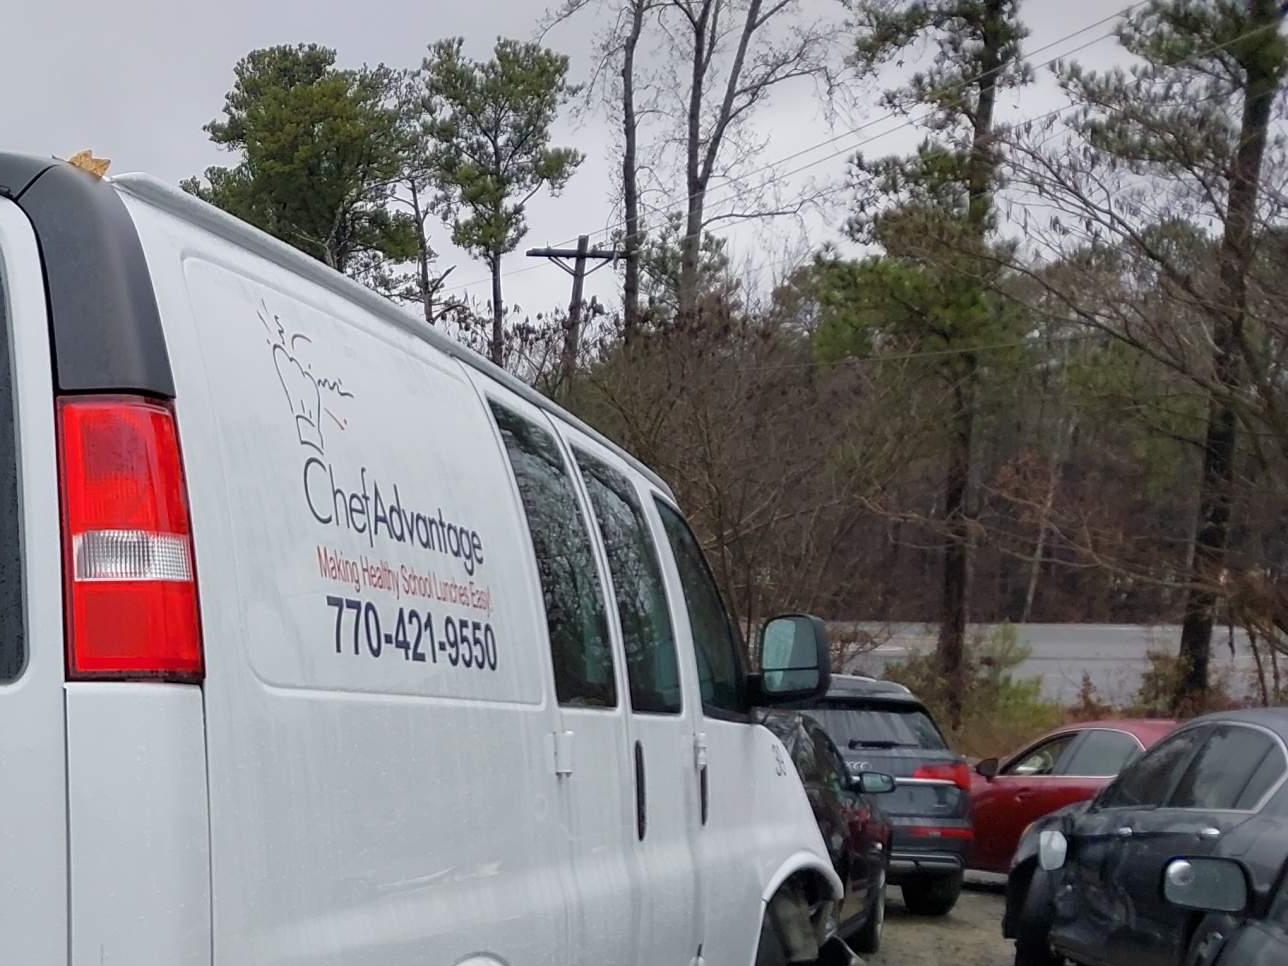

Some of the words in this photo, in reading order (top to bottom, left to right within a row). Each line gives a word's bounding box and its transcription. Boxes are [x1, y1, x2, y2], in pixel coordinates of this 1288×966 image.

[303, 456, 485, 576] ChefAdvantage
[317, 544, 362, 593] Making
[360, 554, 400, 601] Healthy
[400, 563, 432, 599] School
[326, 594, 498, 672] 770-421-9550
